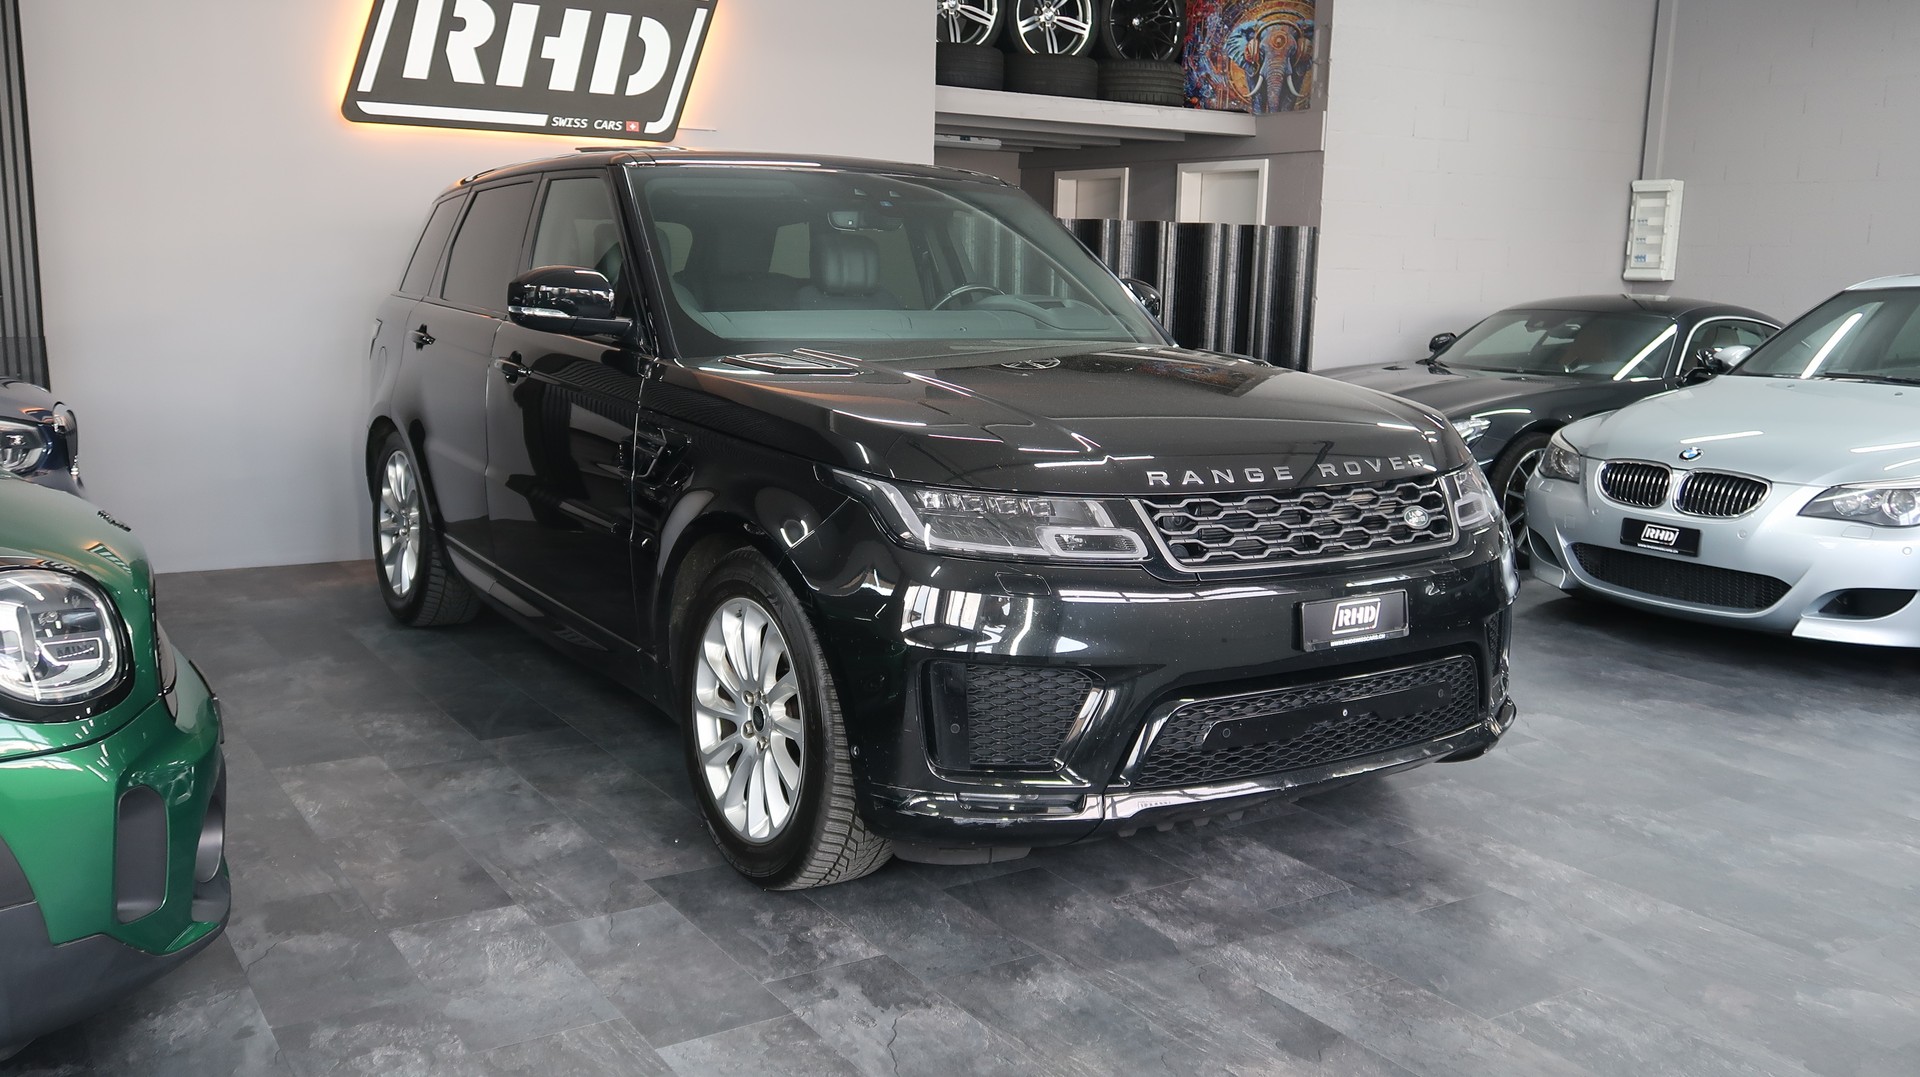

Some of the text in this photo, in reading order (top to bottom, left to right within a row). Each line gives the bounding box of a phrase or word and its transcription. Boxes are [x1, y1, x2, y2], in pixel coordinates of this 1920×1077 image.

[402, 0, 671, 96] RHD
[551, 116, 623, 131] SWISS CARS
[1145, 453, 1425, 487] RANGE ROVER
[1644, 527, 1675, 542] RHD
[1338, 604, 1377, 628] RHD
